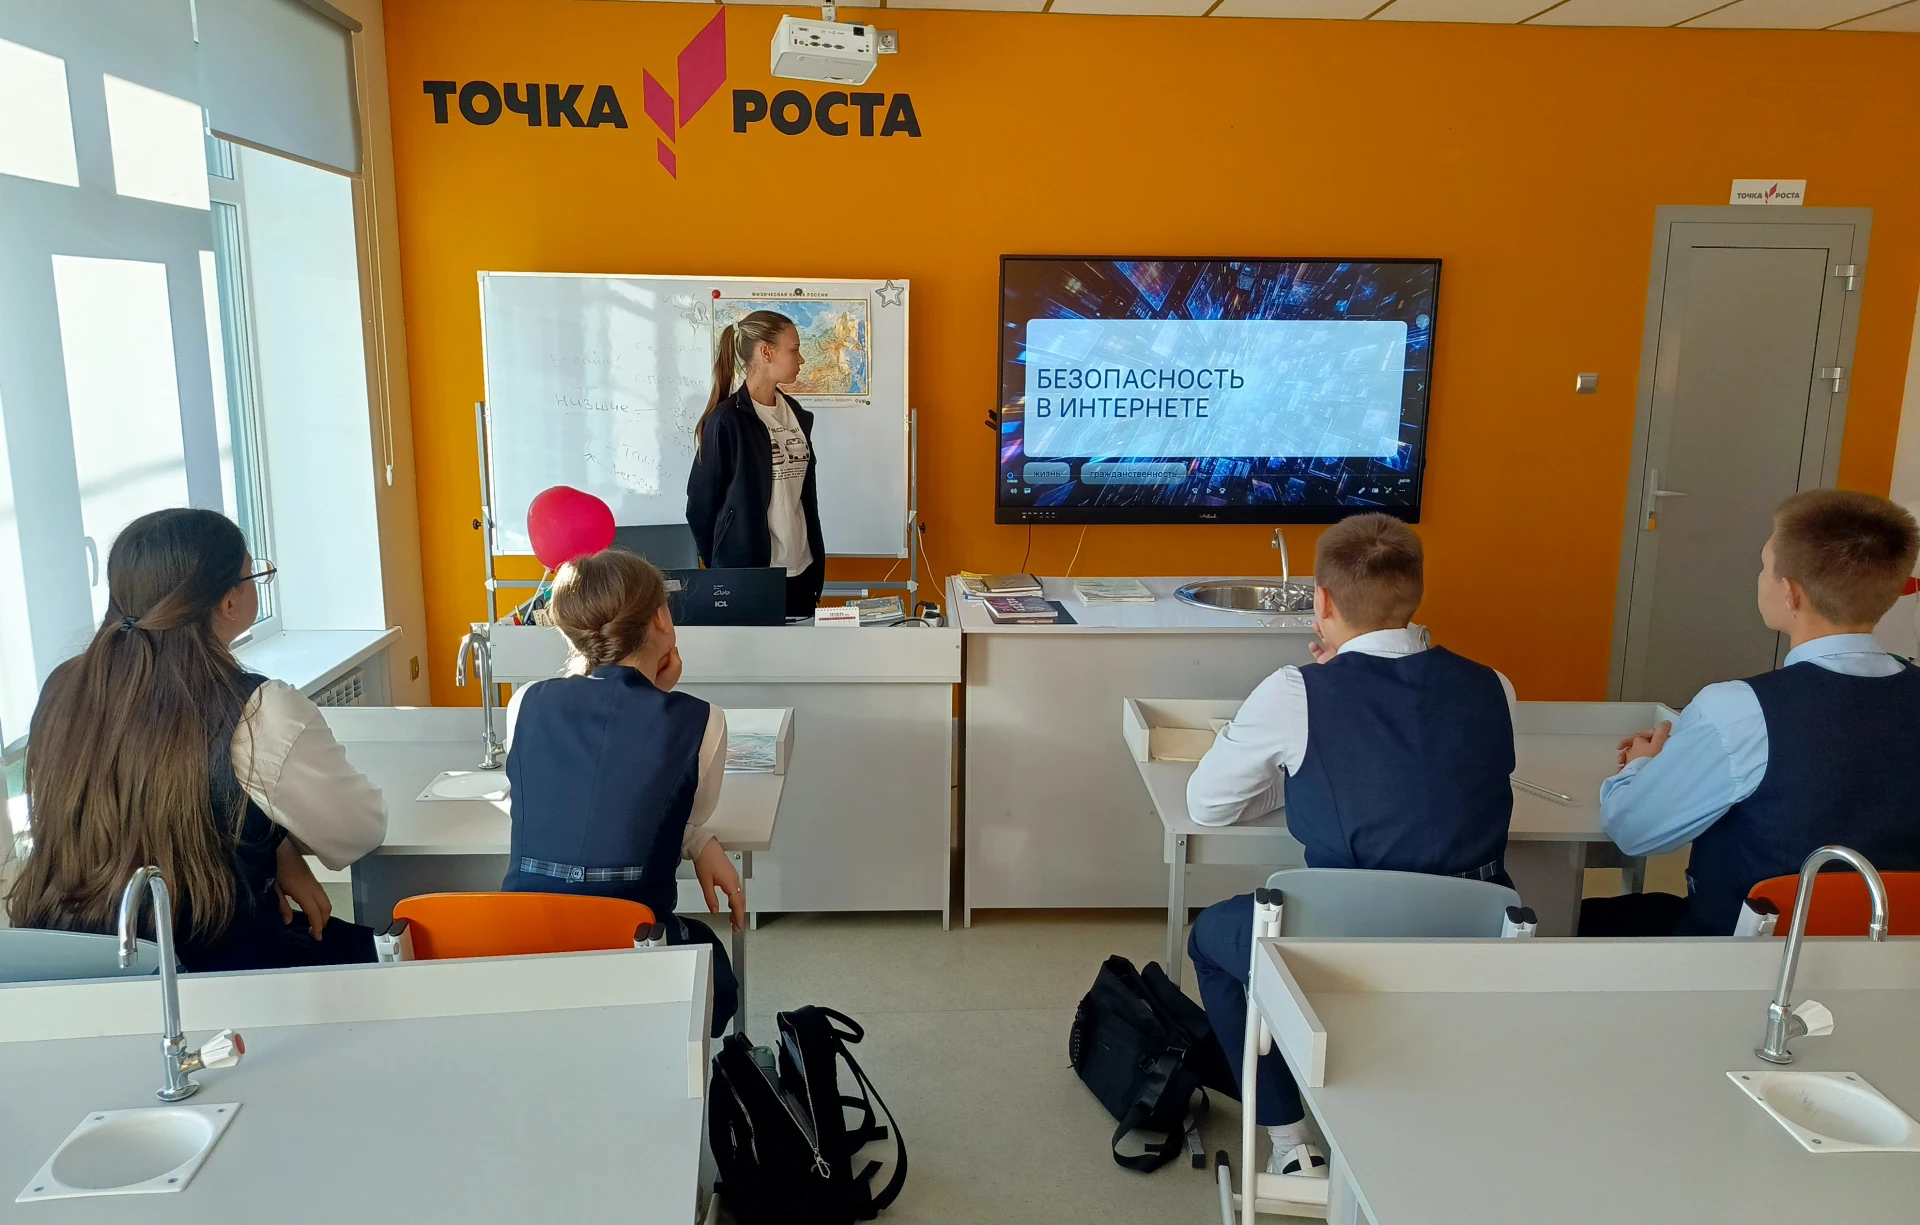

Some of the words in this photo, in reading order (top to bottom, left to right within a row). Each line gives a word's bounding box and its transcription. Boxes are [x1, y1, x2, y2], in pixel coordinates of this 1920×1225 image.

[422, 80, 629, 129] ТОЧКА
[732, 89, 923, 137] РОСТА
[1036, 368, 1246, 390] БЕЗОПАСНОСТЬ
[1036, 397, 1052, 418] В
[1060, 397, 1210, 418] ИНТЕРНЕТЕ
[1089, 471, 1177, 479] гражданственность
